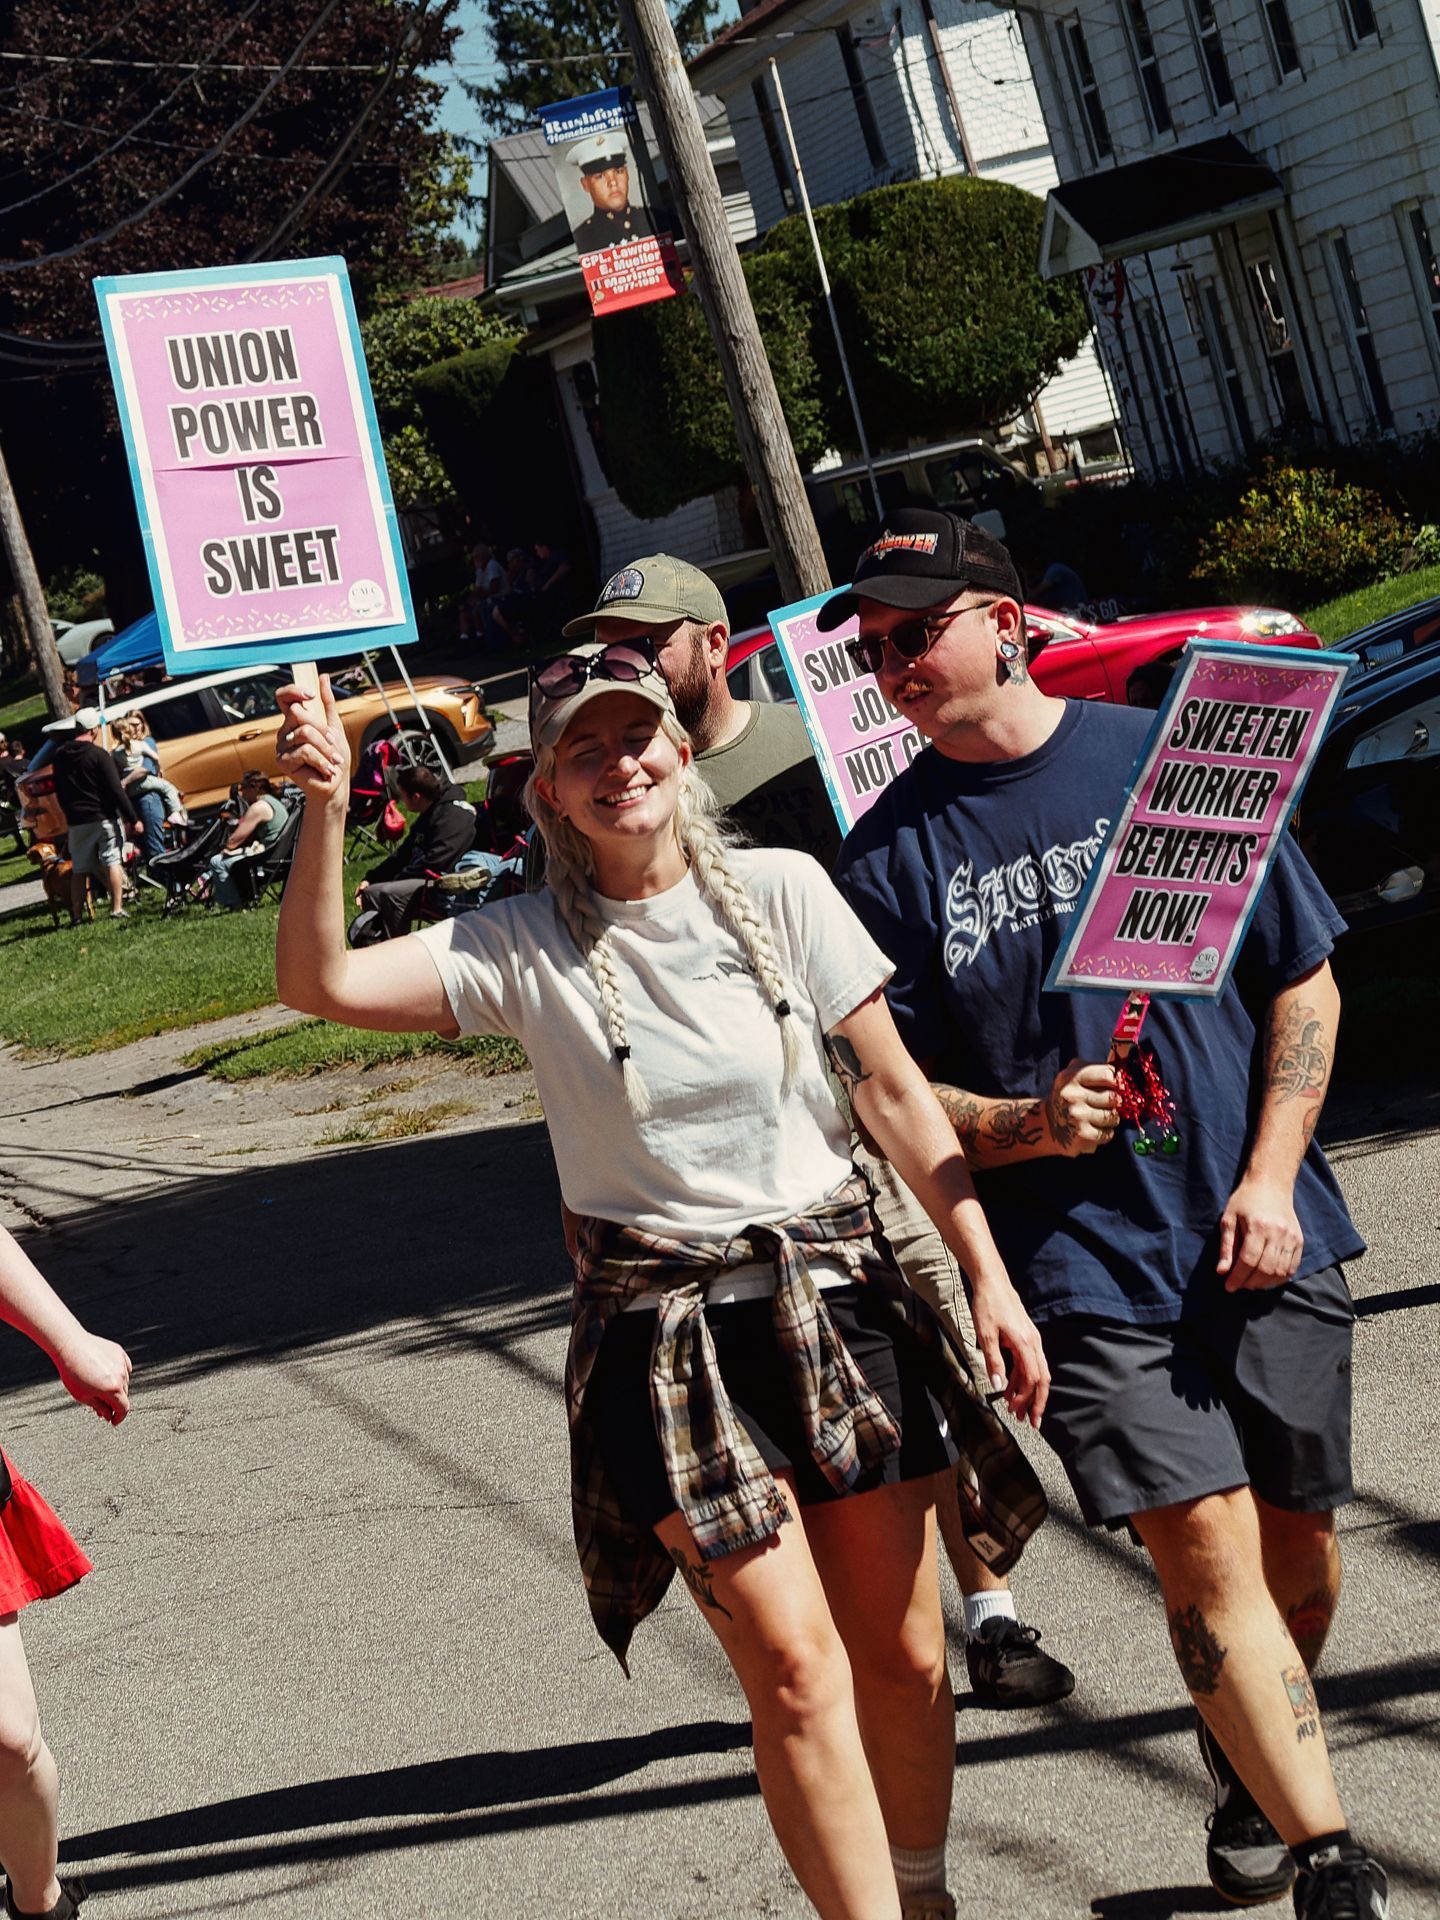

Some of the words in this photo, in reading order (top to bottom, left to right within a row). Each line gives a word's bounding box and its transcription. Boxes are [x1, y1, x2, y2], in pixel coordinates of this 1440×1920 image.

[547, 121, 608, 144] Hometown
[581, 253, 611, 269] CPL.
[598, 263, 613, 276] E.
[613, 250, 661, 271] Mueller
[604, 265, 665, 290] Marines
[167, 327, 300, 391] UNION
[171, 394, 324, 459] POWER
[236, 464, 283, 522] IS
[201, 527, 343, 596] SWEET
[851, 686, 905, 733] JO
[1168, 699, 1312, 760] SWEETEN
[845, 740, 899, 796] NOT
[1148, 761, 1280, 821] WORKER
[1115, 825, 1258, 884] BENEFITS
[1117, 888, 1211, 945] NOW!
